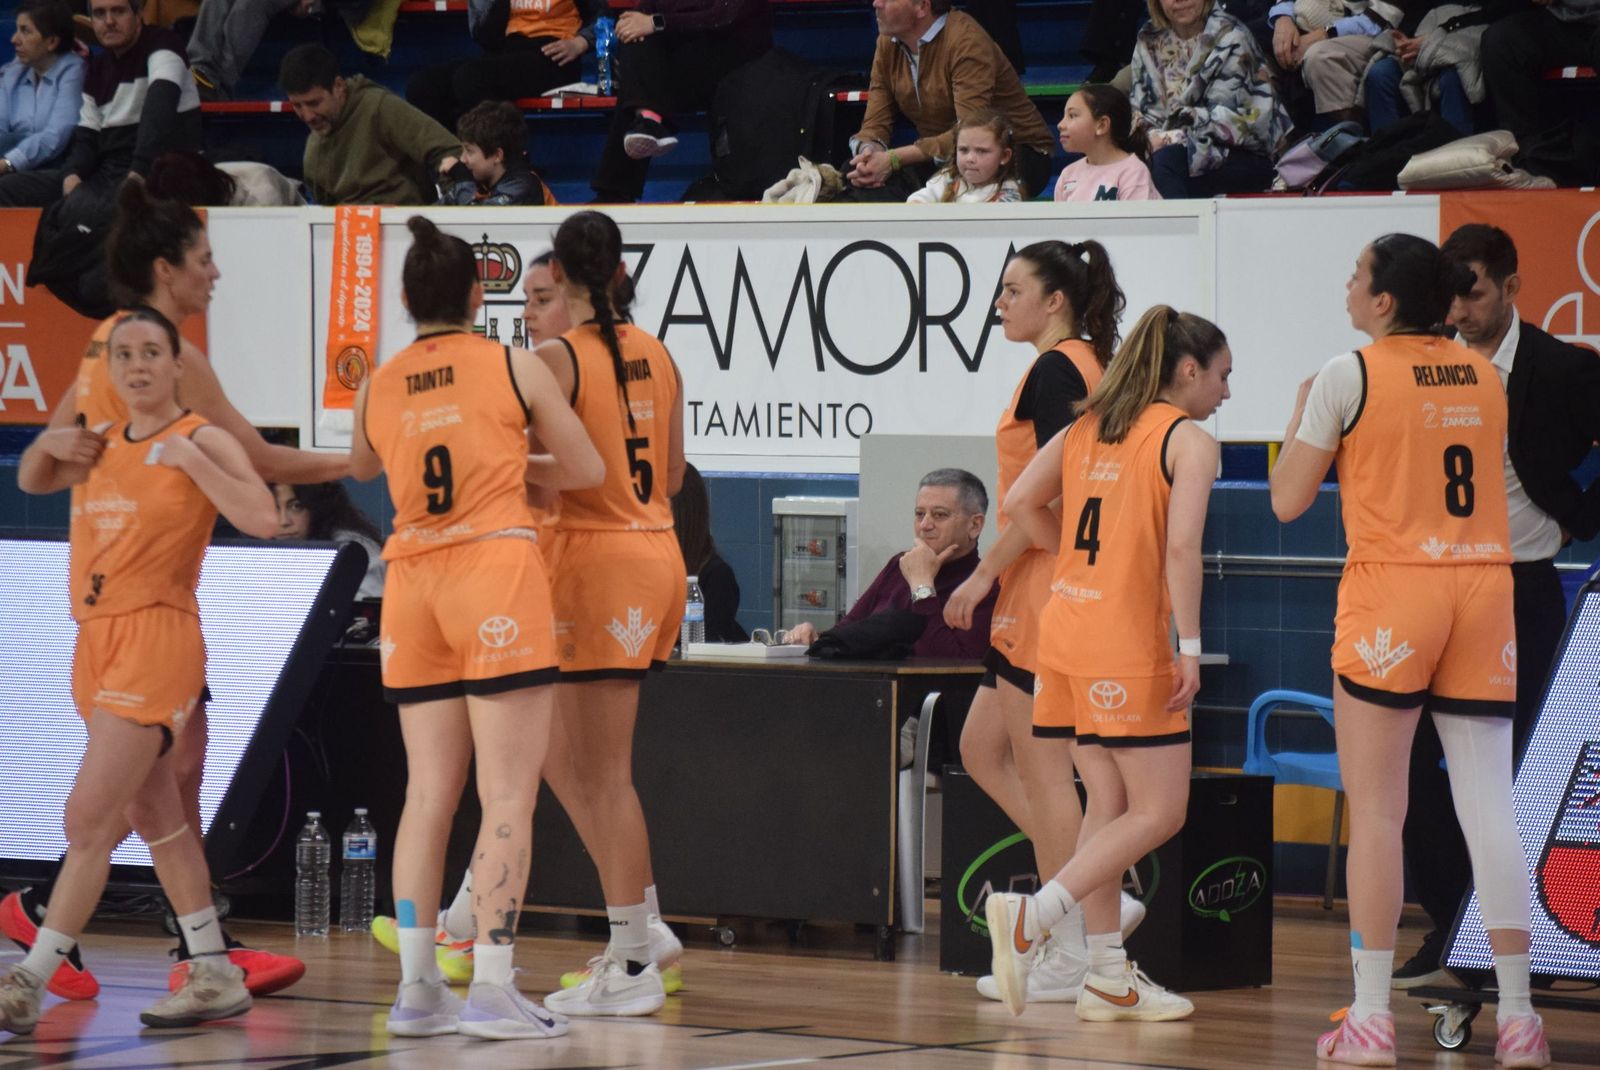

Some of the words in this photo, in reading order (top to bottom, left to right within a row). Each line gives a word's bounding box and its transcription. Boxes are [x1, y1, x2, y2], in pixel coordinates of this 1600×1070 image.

[354, 234, 373, 333] 1994-2024
[405, 365, 455, 396] TAINTA
[1412, 364, 1478, 387] RELANCIO
[687, 401, 873, 440] TAMIENTO
[423, 444, 454, 516] 9
[625, 436, 654, 506] 5
[1443, 444, 1475, 518] 8
[1074, 497, 1103, 566] 4
[1194, 867, 1261, 907] ADOZA
